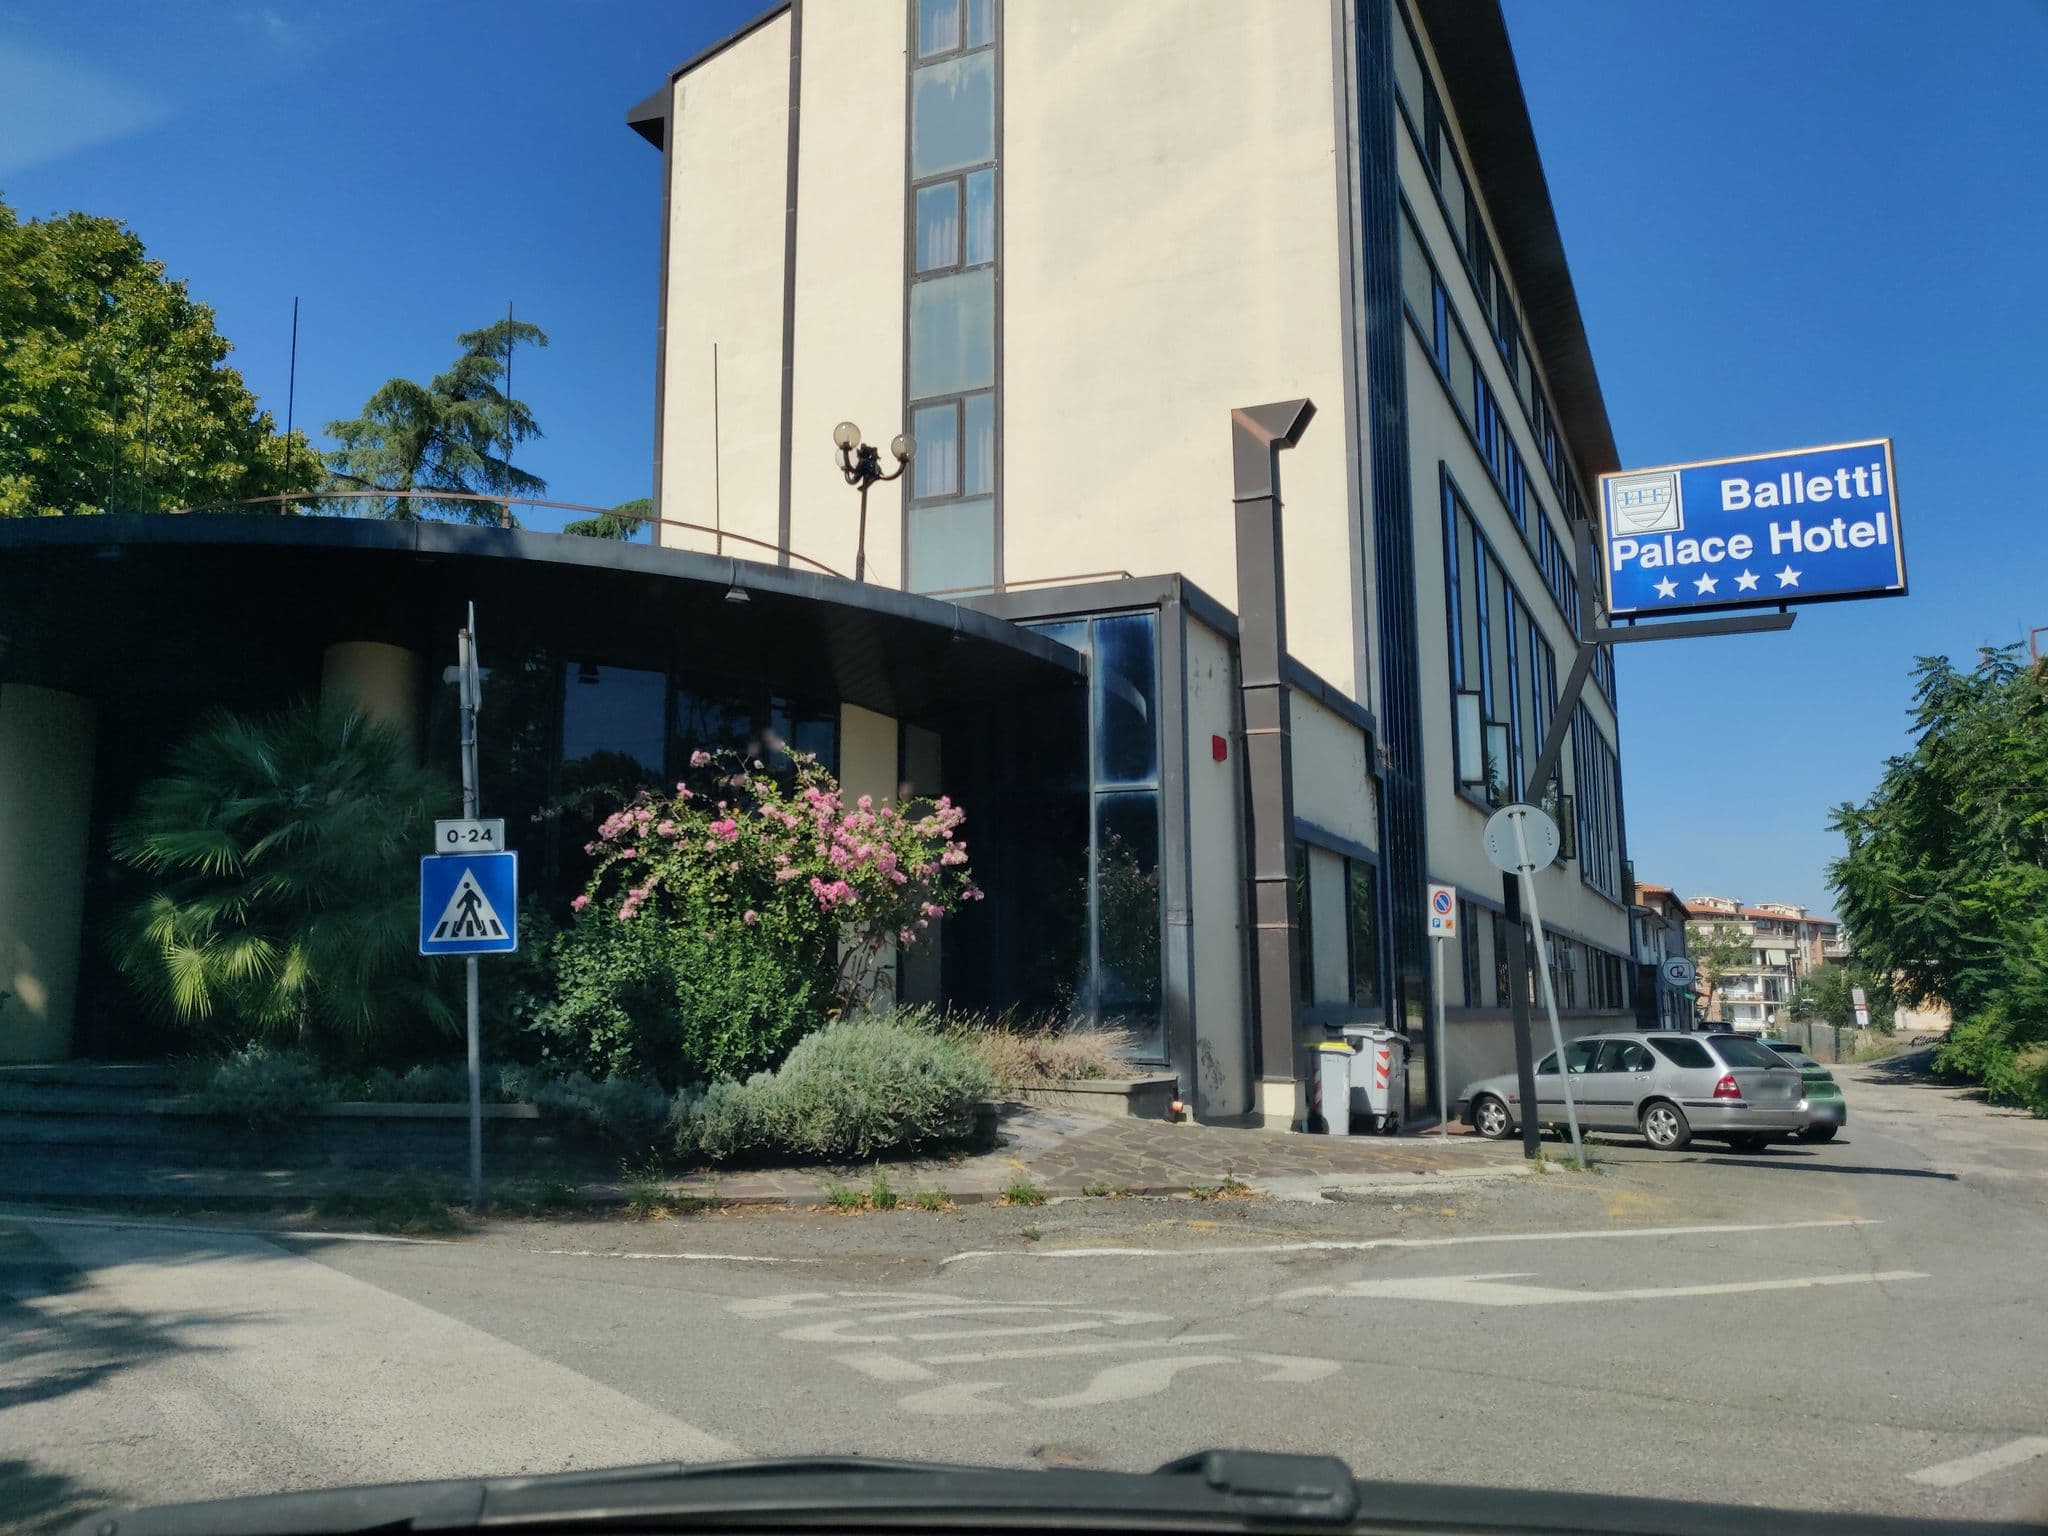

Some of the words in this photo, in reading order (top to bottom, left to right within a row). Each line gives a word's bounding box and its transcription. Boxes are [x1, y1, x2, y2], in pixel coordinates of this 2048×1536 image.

[1721, 463, 1882, 511] Balletti
[1612, 534, 1753, 571] Palace
[1769, 512, 1888, 555] Hotel
[447, 829, 493, 843] 0-24
